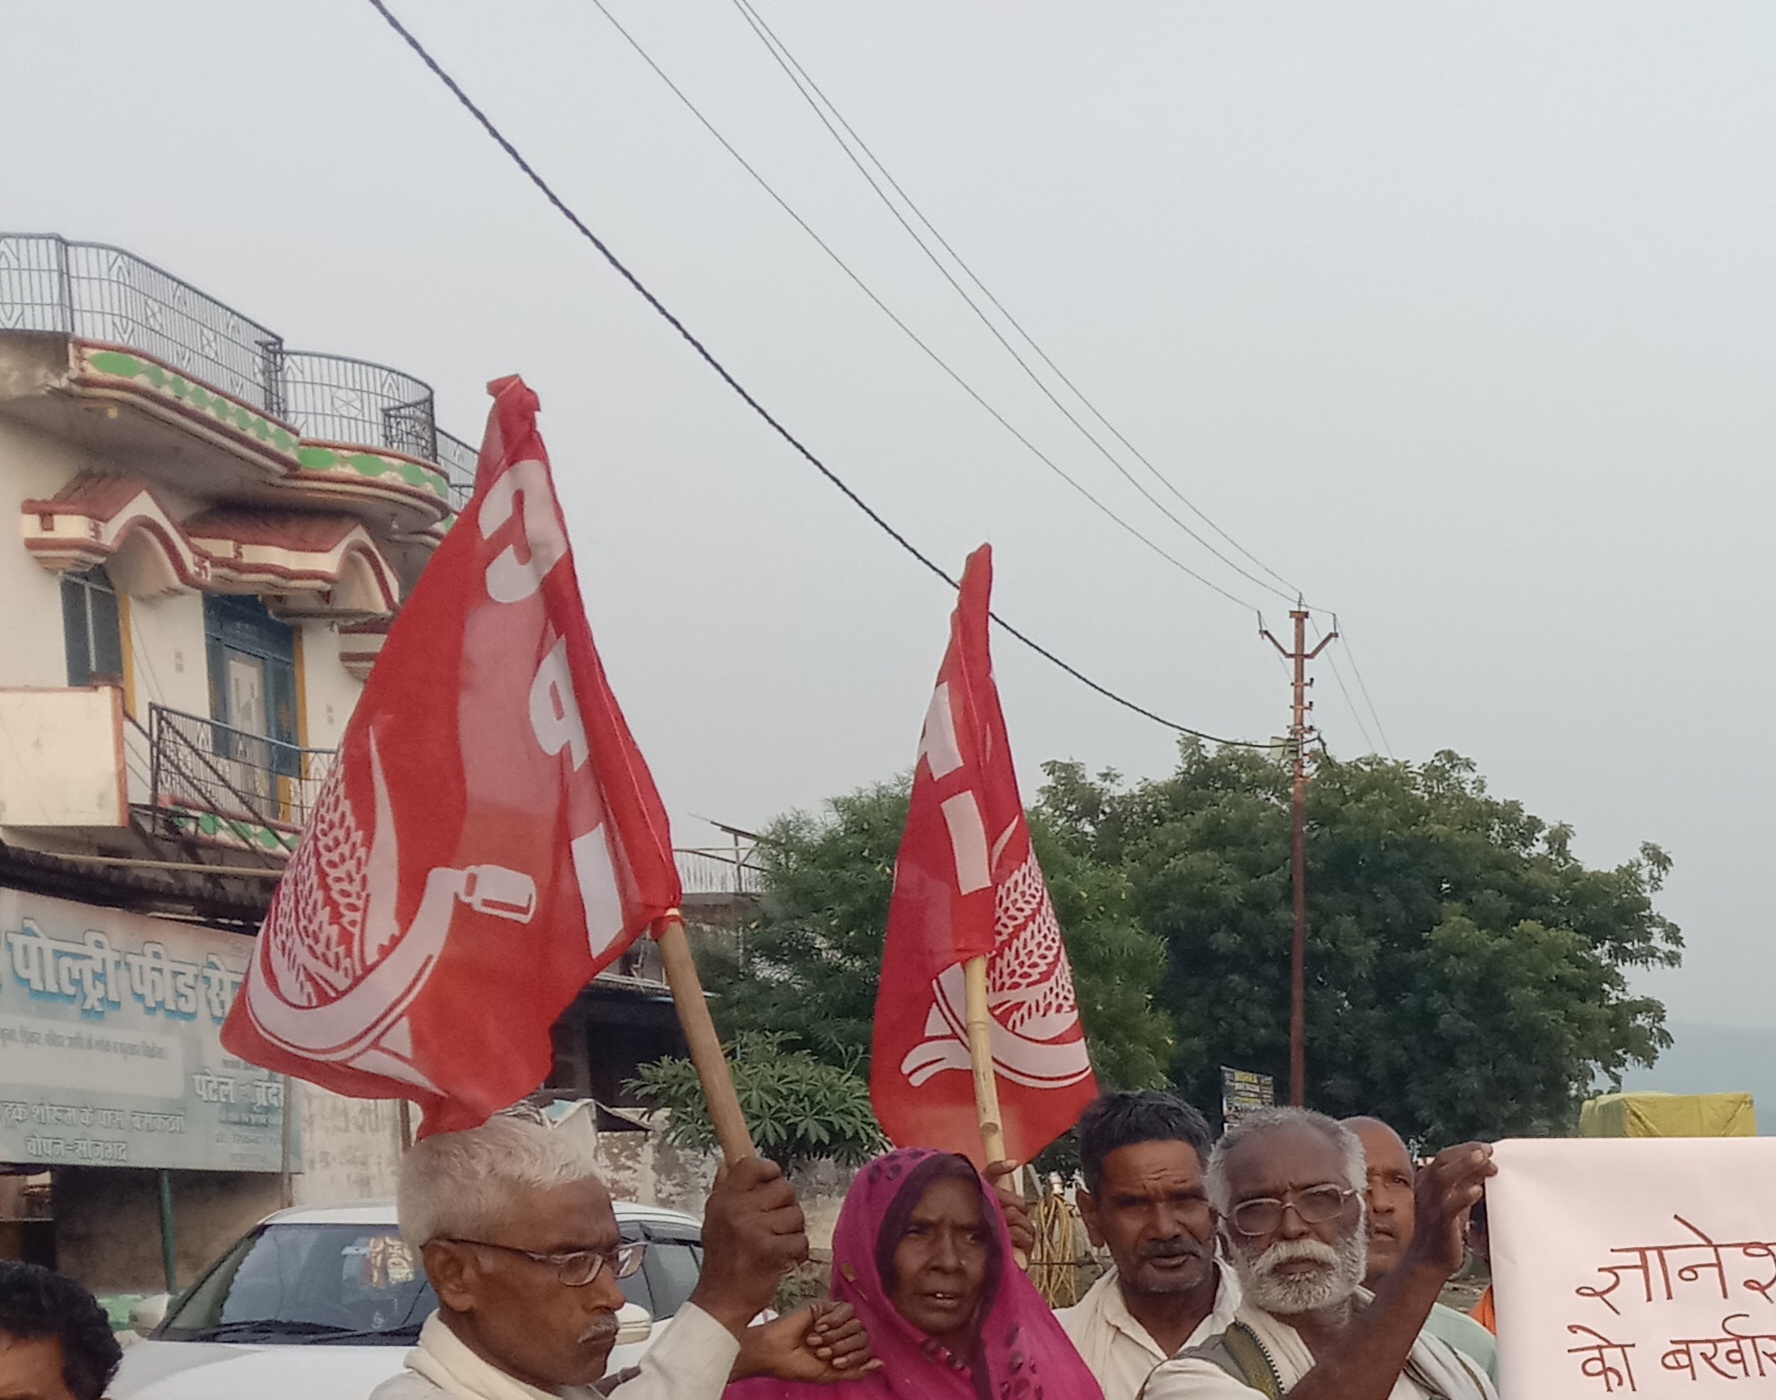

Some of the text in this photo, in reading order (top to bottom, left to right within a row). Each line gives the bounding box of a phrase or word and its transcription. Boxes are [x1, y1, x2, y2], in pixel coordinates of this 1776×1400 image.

[5, 917, 122, 1018] पोल्ट्री
[124, 941, 199, 1017] फीड
[192, 1066, 235, 1105] पटेल
[79, 1100, 94, 1127] के
[97, 1108, 124, 1129] पास
[1567, 1324, 1637, 1393] को
